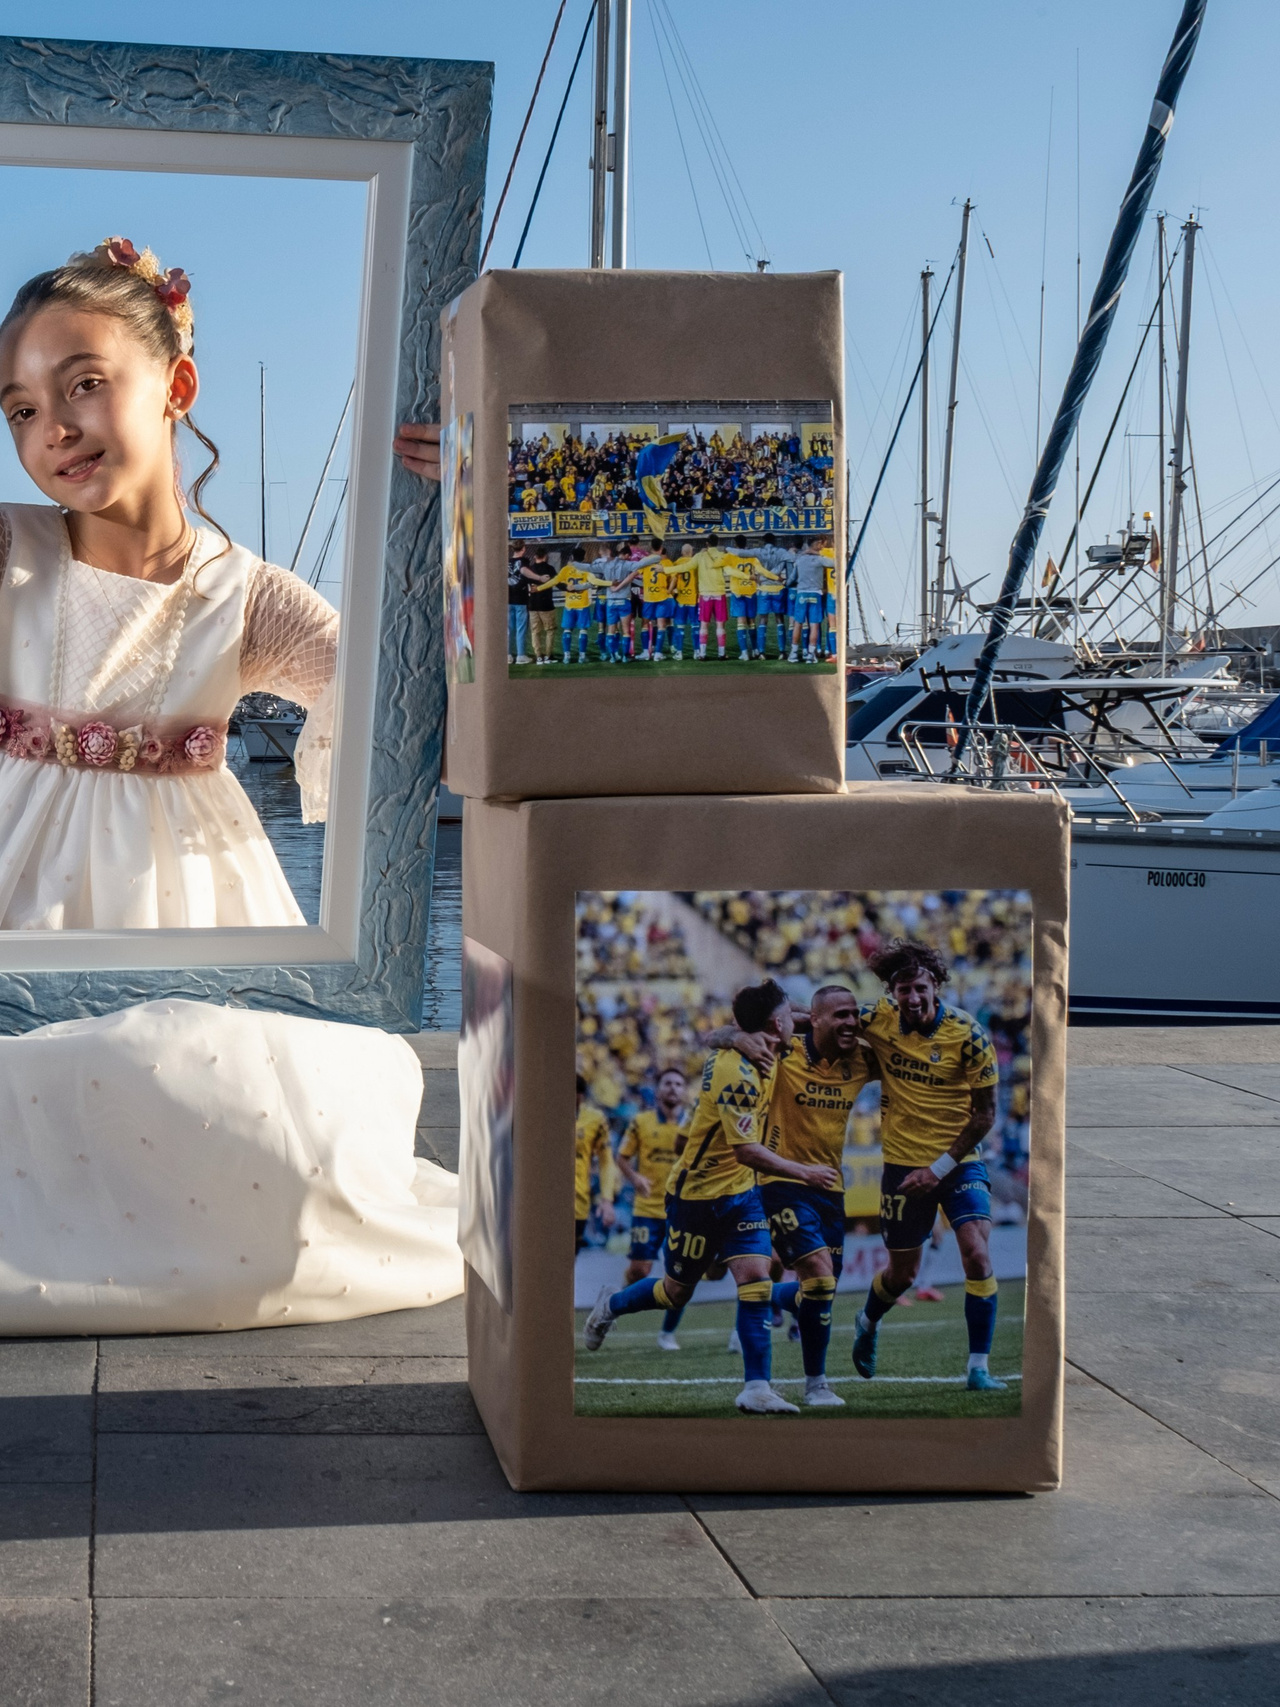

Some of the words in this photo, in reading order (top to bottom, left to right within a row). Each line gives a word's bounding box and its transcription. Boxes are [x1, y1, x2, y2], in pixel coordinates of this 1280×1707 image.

[516, 522, 549, 531] AVANTE
[889, 1052, 930, 1073] Gran
[805, 1081, 842, 1097] Gran
[795, 1092, 854, 1110] Canaria
[771, 1207, 799, 1235] 19
[682, 1231, 707, 1260] 10
